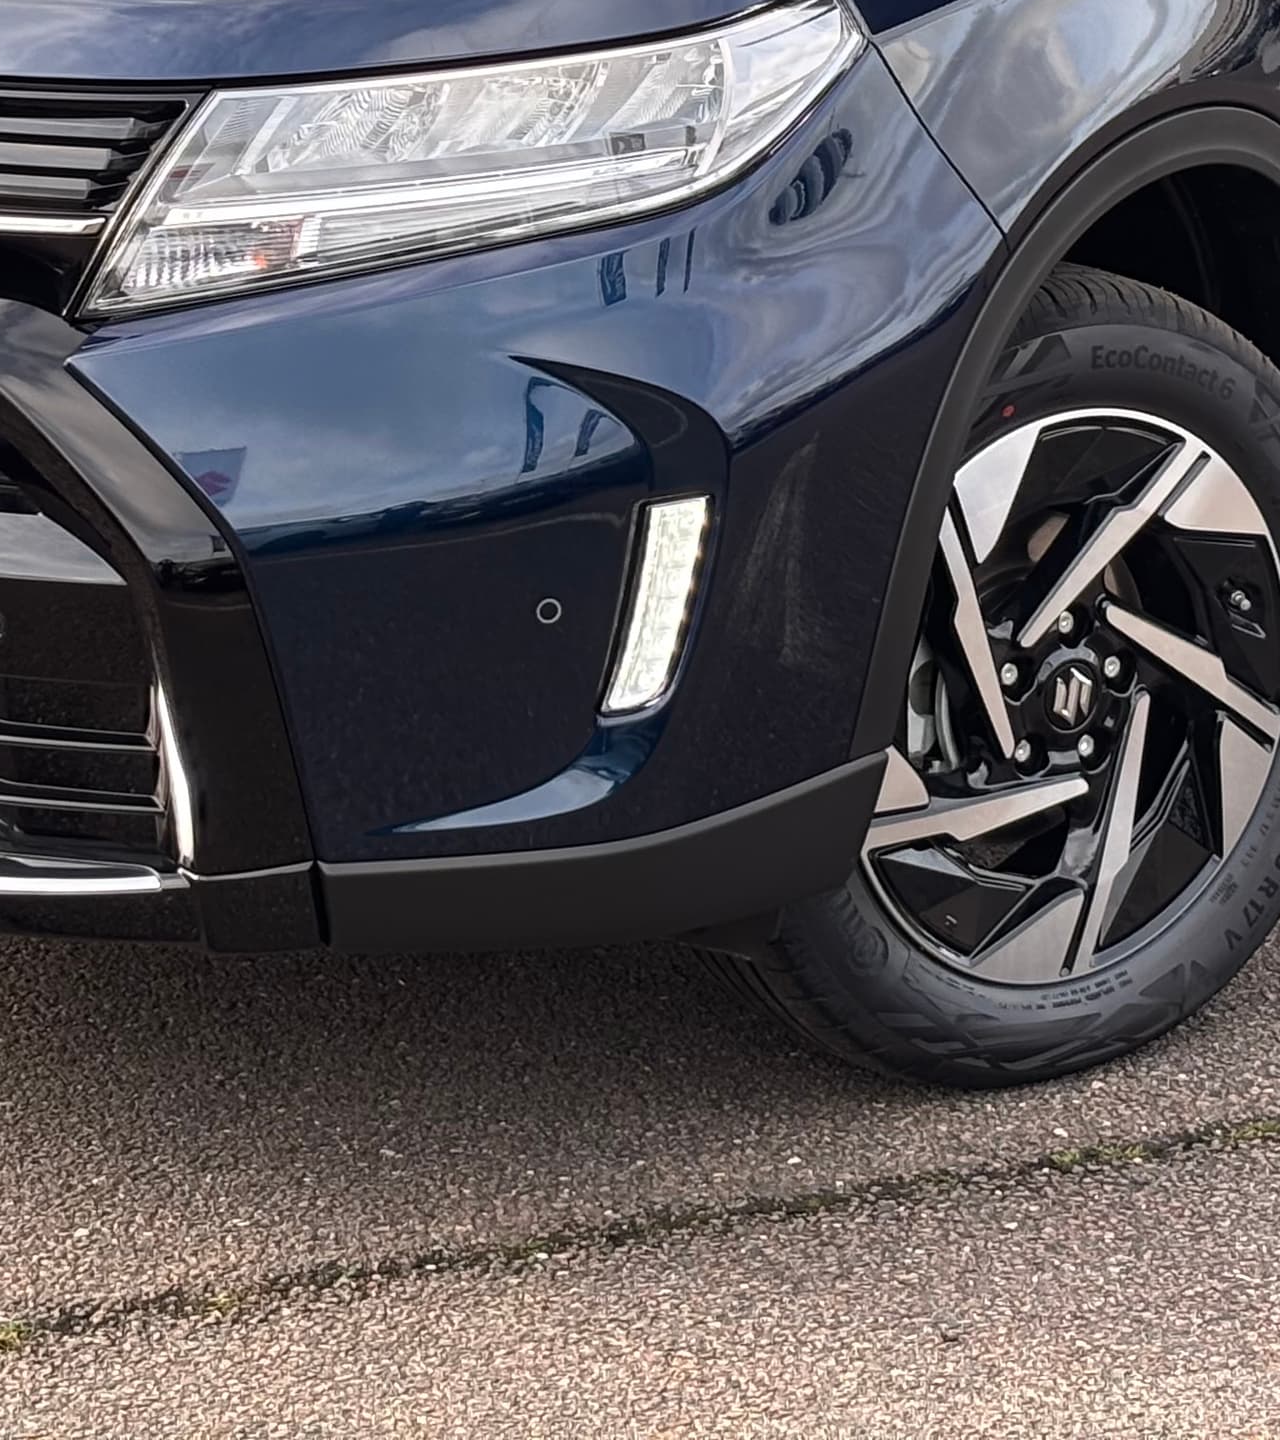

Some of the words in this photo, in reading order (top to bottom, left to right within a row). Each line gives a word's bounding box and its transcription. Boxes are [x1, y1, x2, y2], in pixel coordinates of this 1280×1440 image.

[1089, 344, 1218, 393] EcoContact
[1221, 377, 1237, 400] 6
[1258, 876, 1280, 899] R
[1242, 897, 1265, 928] 17
